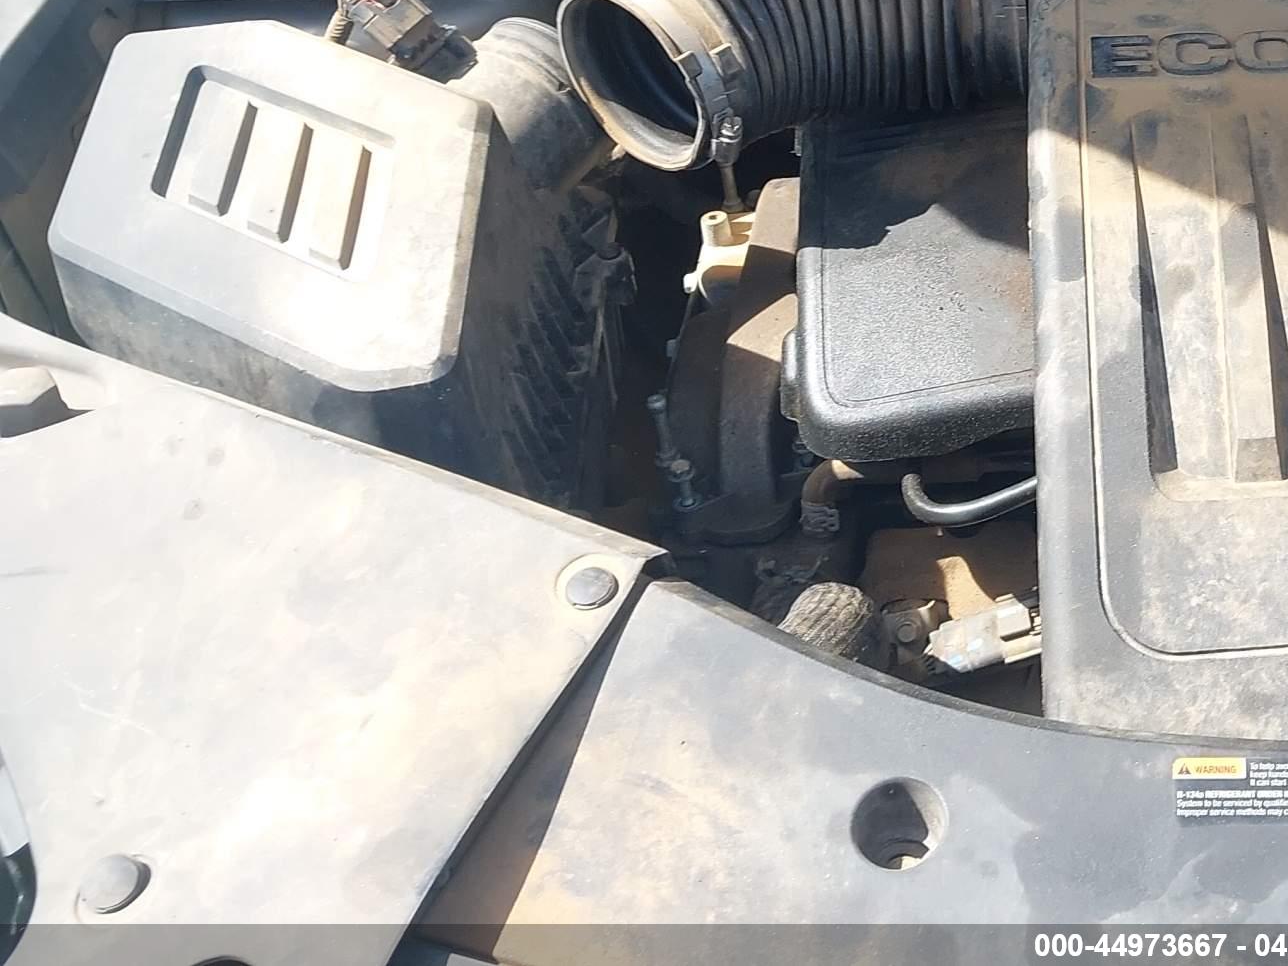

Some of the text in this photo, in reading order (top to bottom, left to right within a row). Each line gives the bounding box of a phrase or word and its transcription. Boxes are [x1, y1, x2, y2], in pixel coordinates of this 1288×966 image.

[1195, 765, 1237, 774] WARNING
[1177, 799, 1203, 808] System
[1253, 800, 1262, 808] by
[1177, 809, 1208, 817] Improper
[1236, 808, 1266, 816] methods
